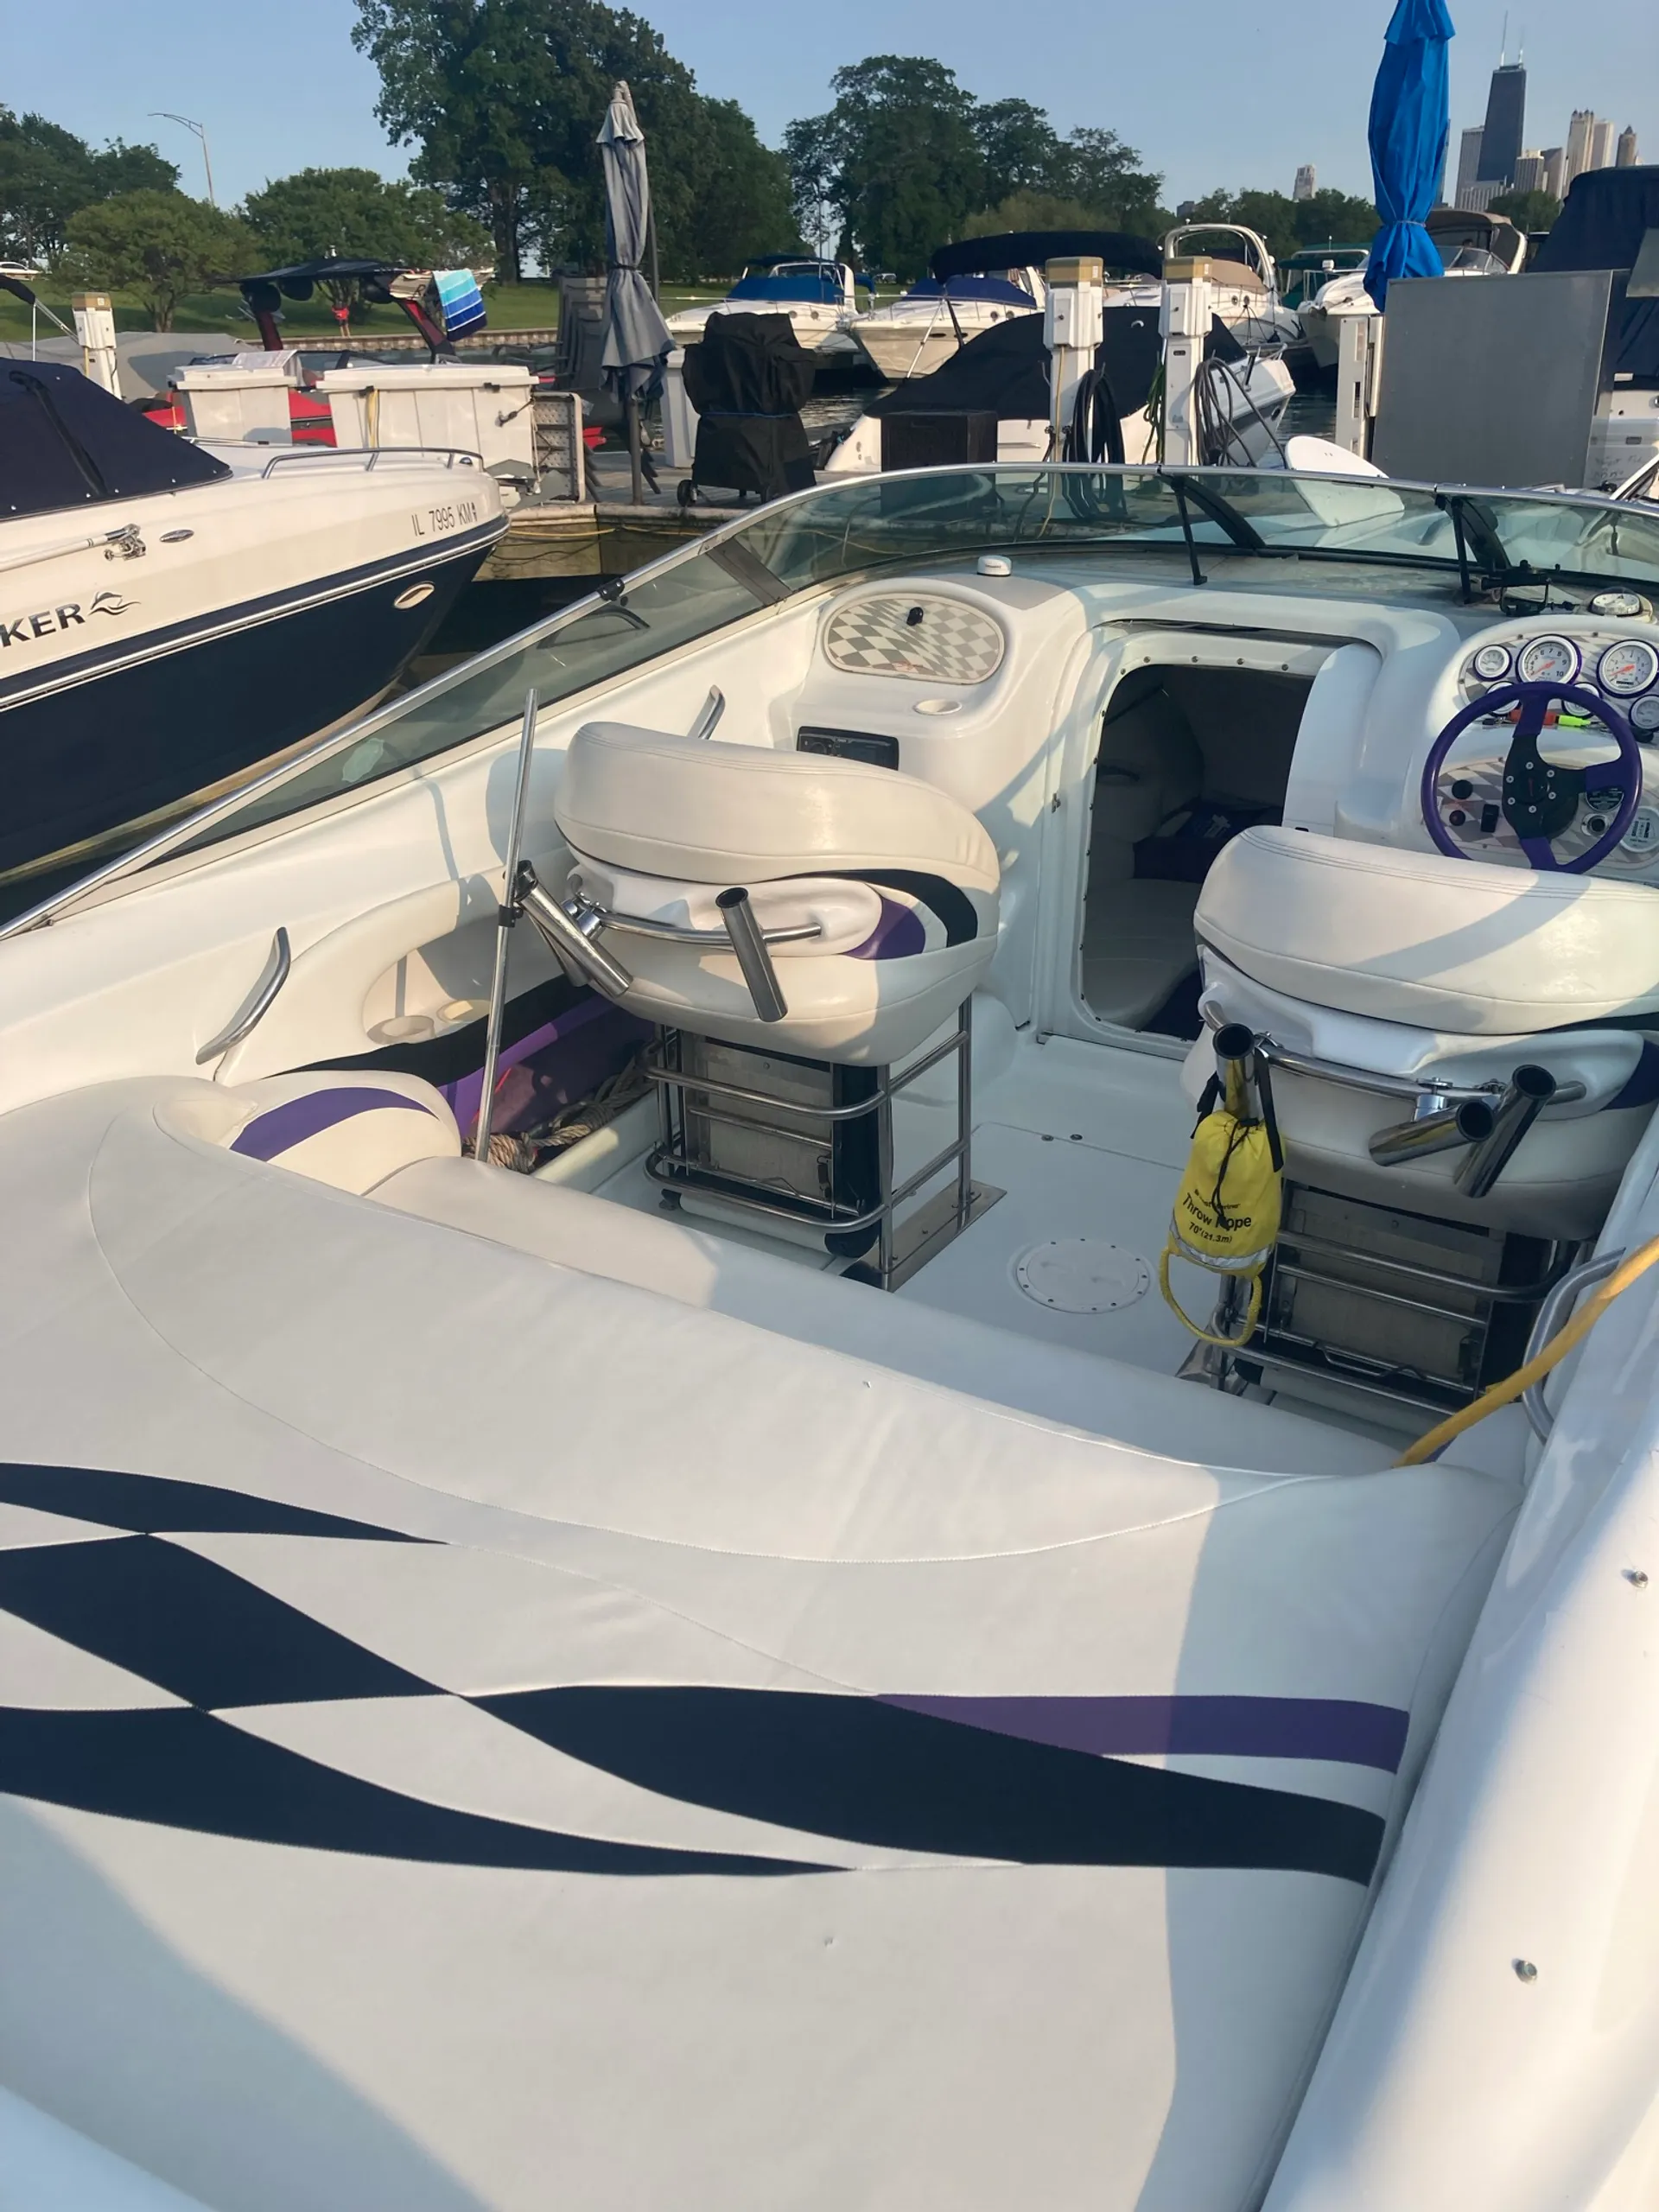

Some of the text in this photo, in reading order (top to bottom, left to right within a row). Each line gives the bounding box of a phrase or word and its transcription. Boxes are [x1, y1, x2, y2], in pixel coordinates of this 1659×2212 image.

[411, 514, 425, 536] IL
[429, 506, 455, 531] 7995
[0, 603, 86, 647] KER
[1183, 1192, 1213, 1225] Throw
